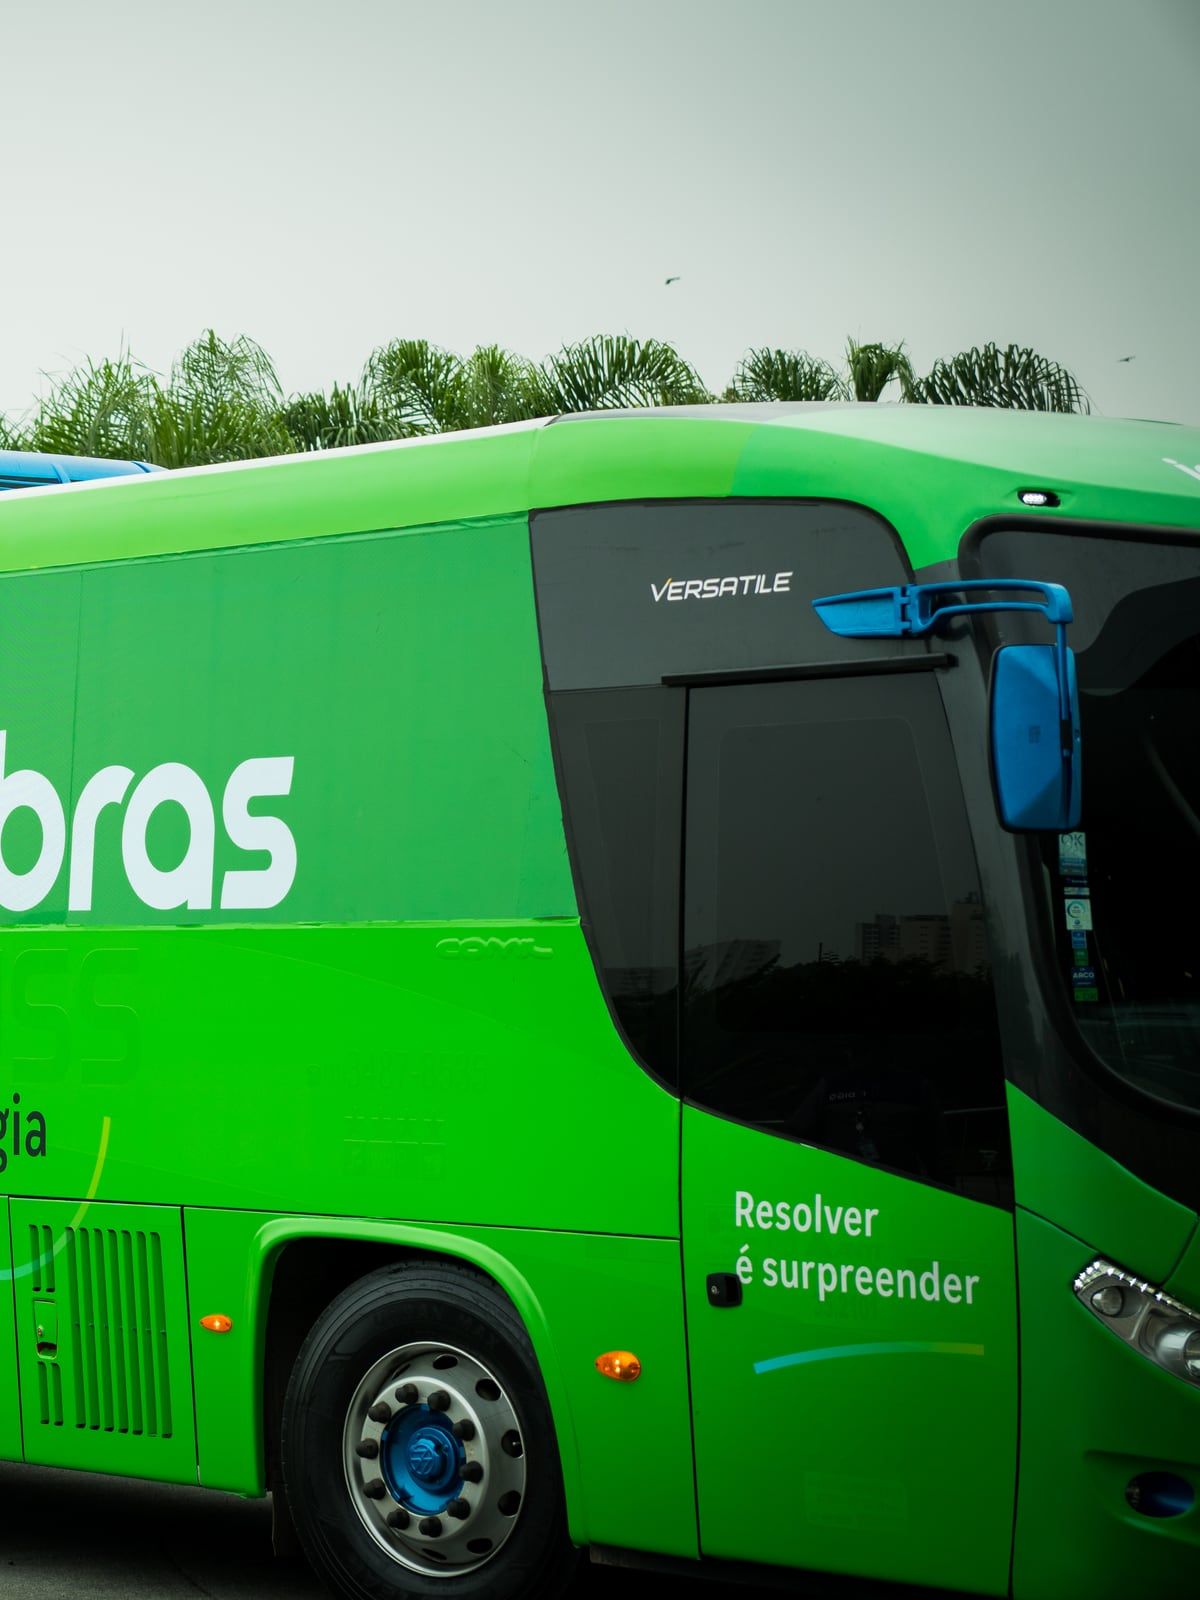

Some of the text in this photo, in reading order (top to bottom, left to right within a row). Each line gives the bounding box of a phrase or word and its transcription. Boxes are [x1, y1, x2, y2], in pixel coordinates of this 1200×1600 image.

[650, 571, 794, 603] VERSATILE
[735, 1191, 880, 1237] Resolver
[736, 1244, 980, 1304] é surpreender
